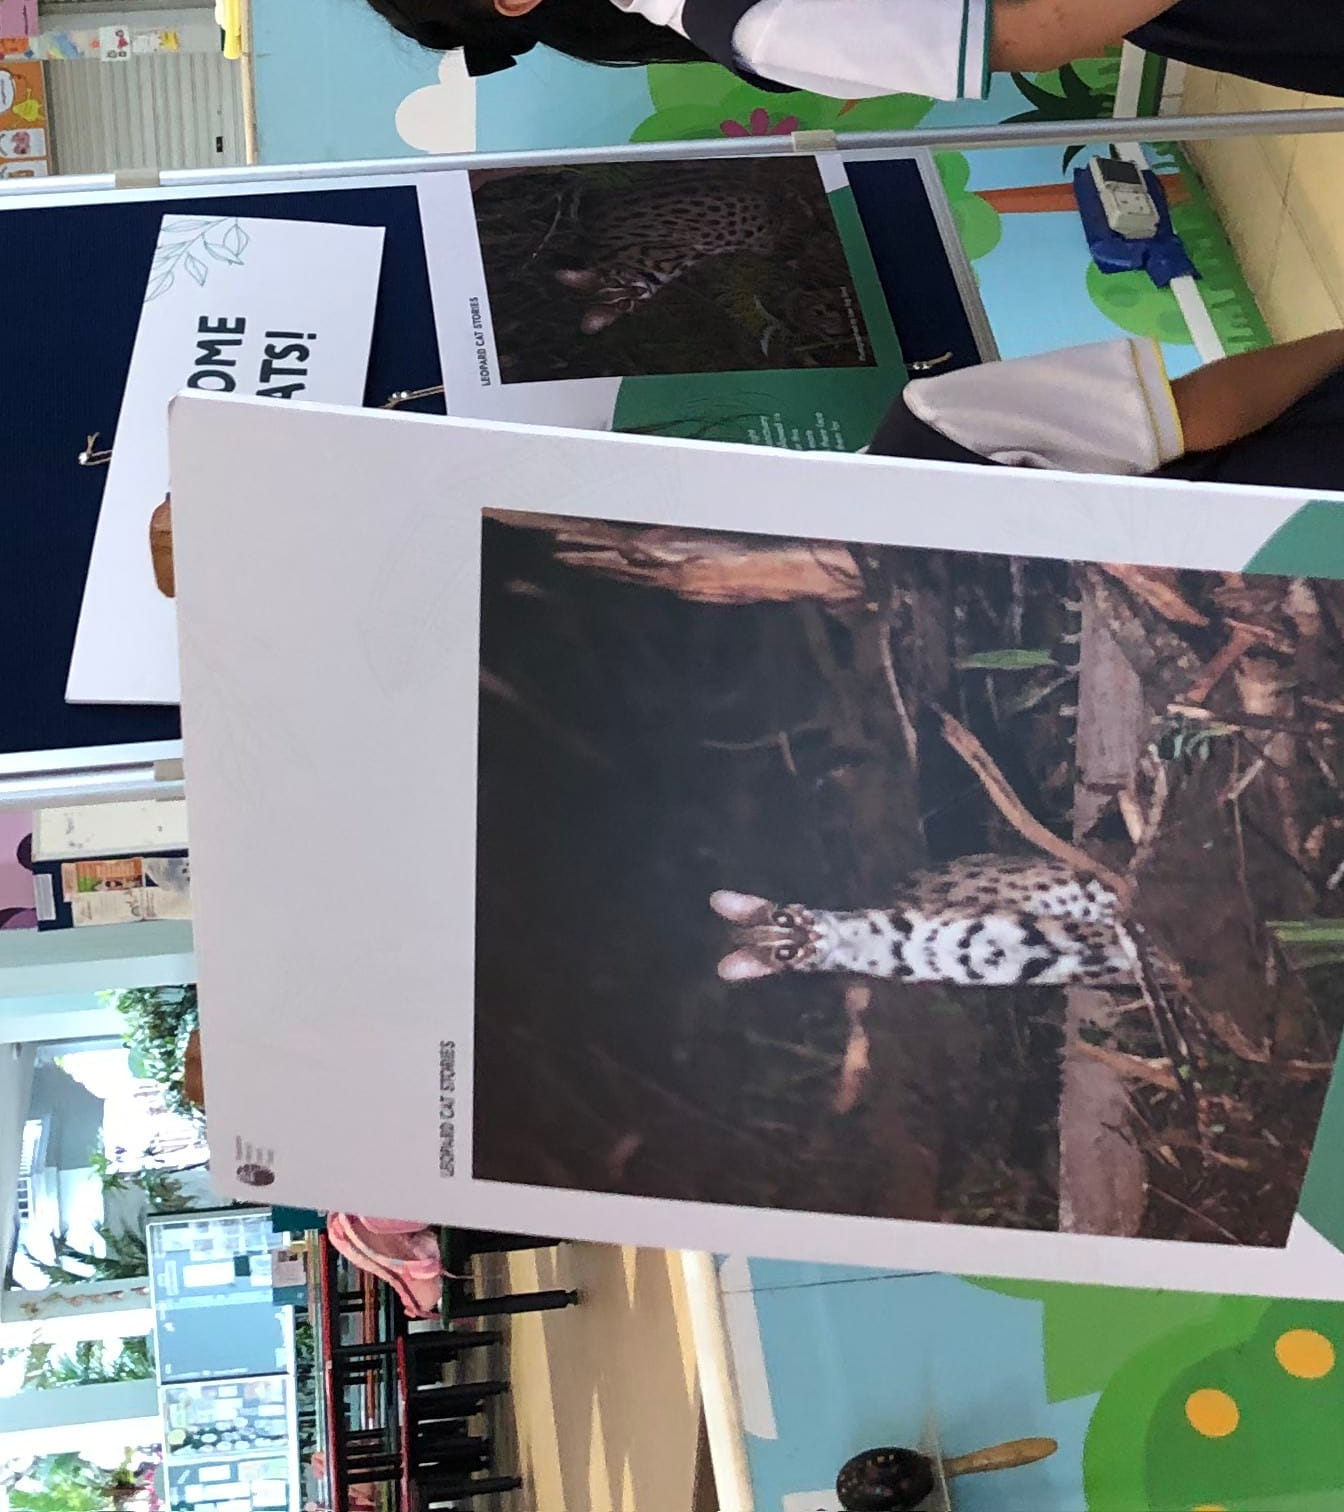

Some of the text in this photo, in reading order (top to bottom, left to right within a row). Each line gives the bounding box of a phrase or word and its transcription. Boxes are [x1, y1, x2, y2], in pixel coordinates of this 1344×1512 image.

[255, 331, 317, 399] ATS!
[469, 297, 491, 386] LEOPARD CAT STORIES
[440, 1041, 455, 1177] LEOPARD CAT STORIES
